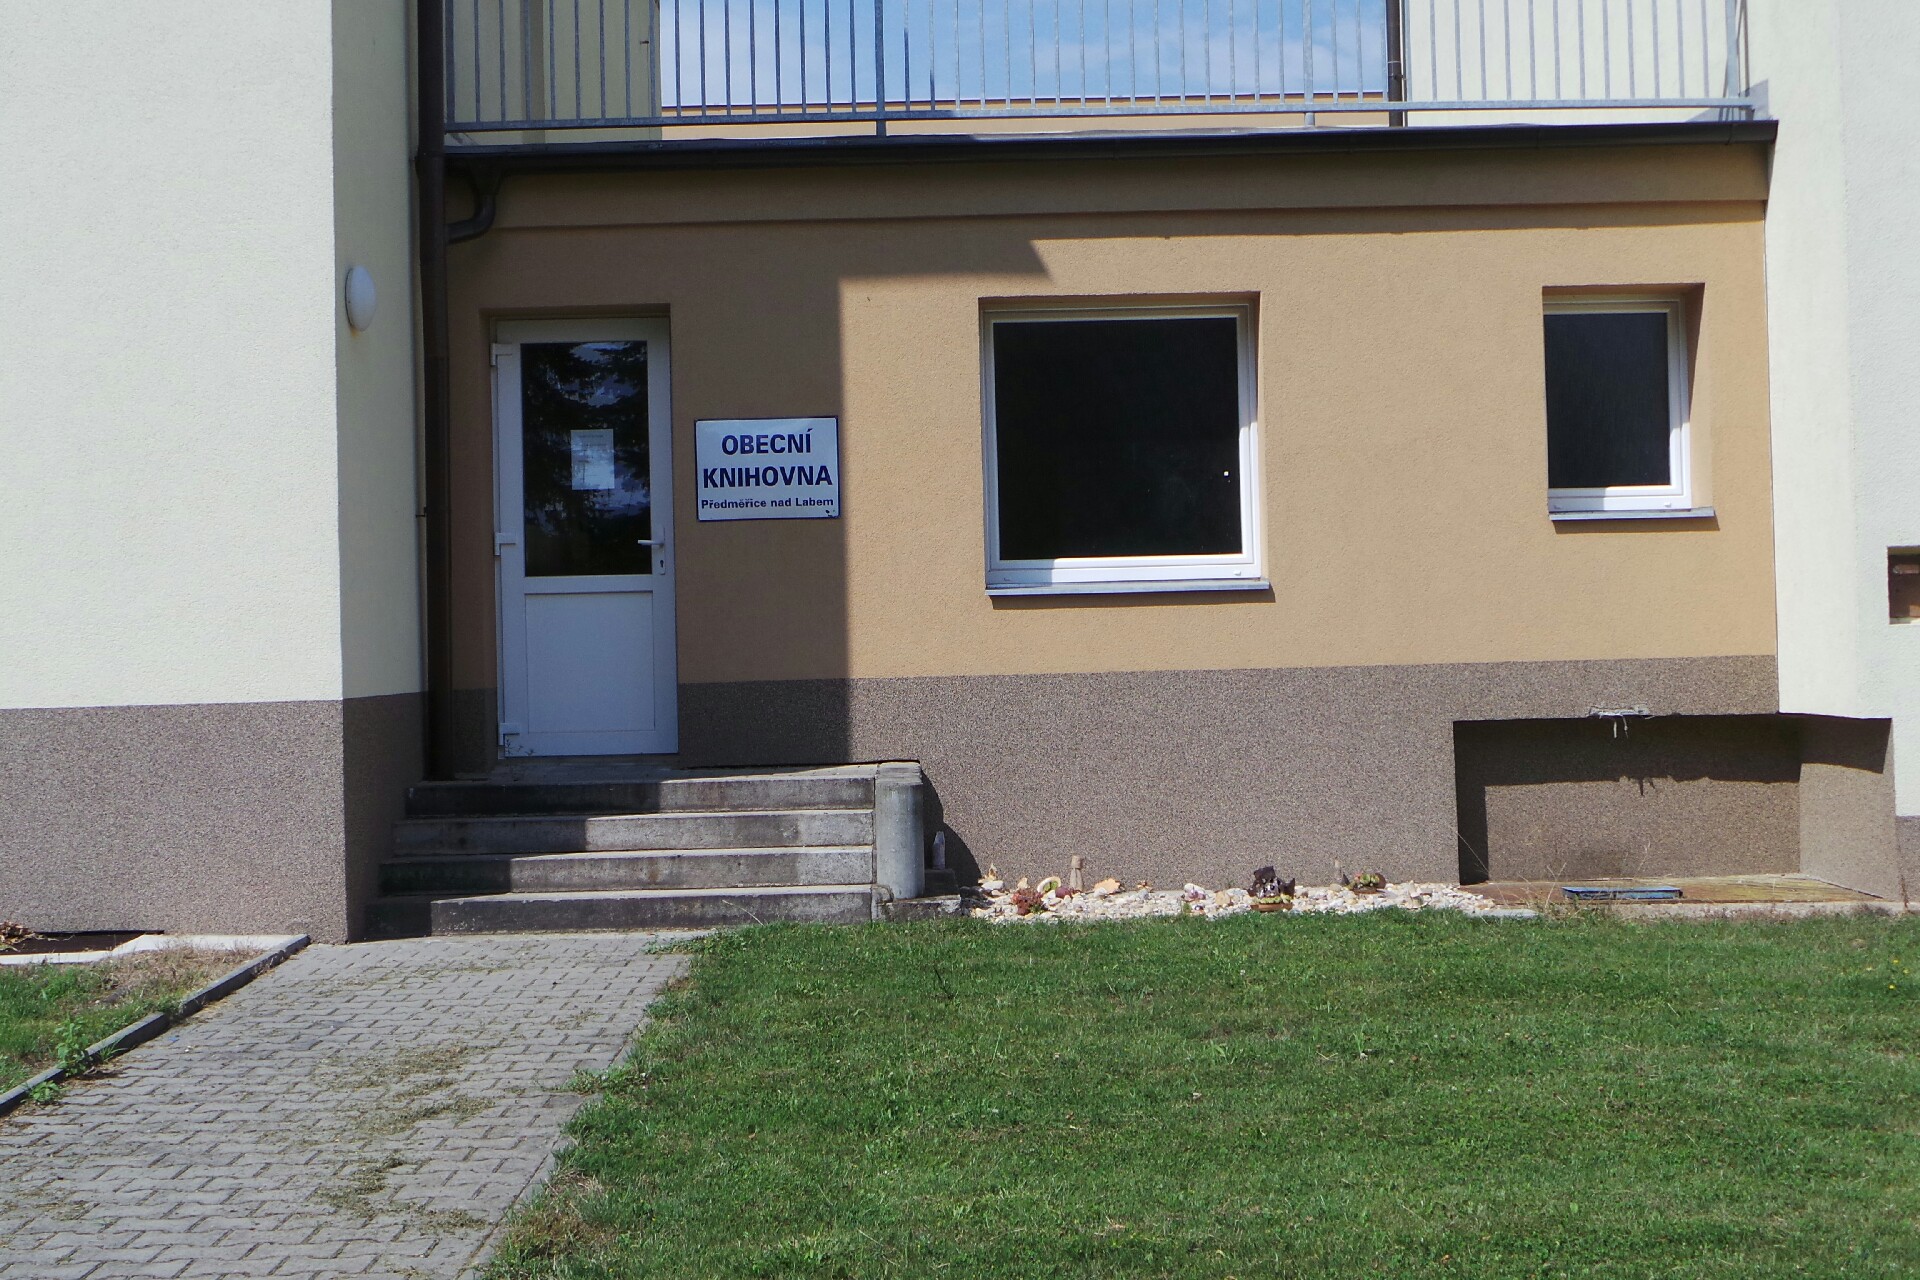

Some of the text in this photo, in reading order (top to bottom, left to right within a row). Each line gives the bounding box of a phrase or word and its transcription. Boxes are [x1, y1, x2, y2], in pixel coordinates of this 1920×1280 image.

[722, 428, 813, 455] OBECNÍ
[703, 465, 833, 488] KNIHOVNA
[701, 497, 834, 509] Předměřice nad Labem
